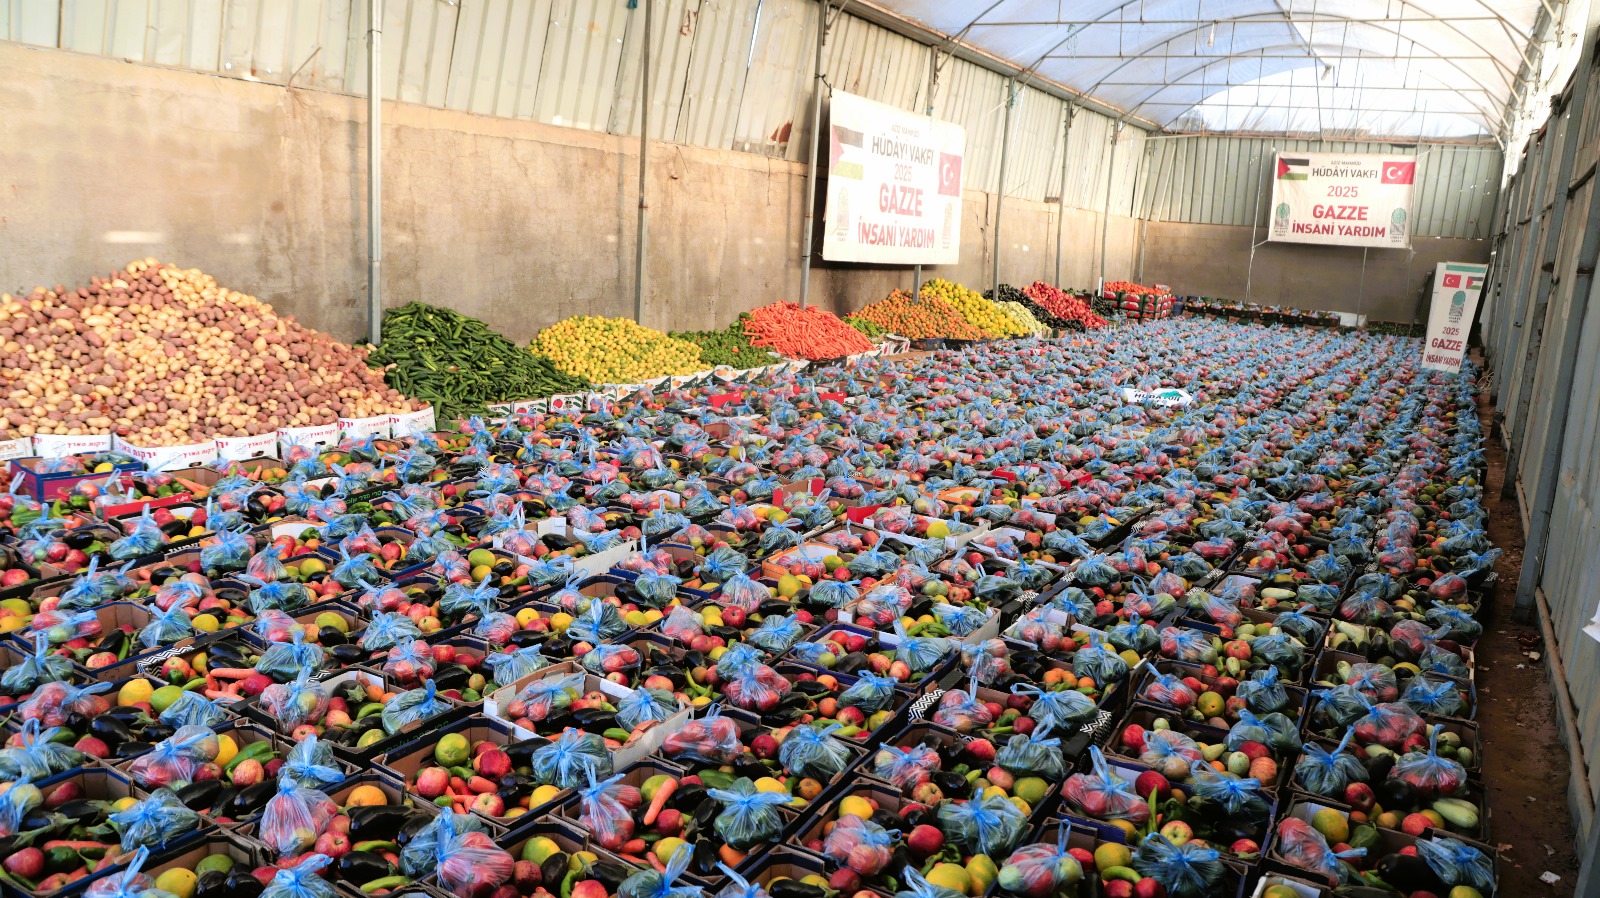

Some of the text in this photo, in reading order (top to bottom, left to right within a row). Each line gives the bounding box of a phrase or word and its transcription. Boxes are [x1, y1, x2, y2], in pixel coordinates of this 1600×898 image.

[910, 144, 934, 166] VAKFI
[894, 163, 912, 182] 2025
[1312, 165, 1378, 179] HÜDÂYİ VAKFI
[879, 182, 923, 217] GAZZE
[1327, 185, 1358, 198] 2025
[1312, 204, 1369, 221] GAZZE
[858, 215, 935, 249] İNSANİ YARDIM
[1291, 219, 1335, 235] İNSANİ
[1337, 225, 1386, 238] YARDIM
[1442, 327, 1459, 336] 2025
[1432, 338, 1462, 351] GAZZE
